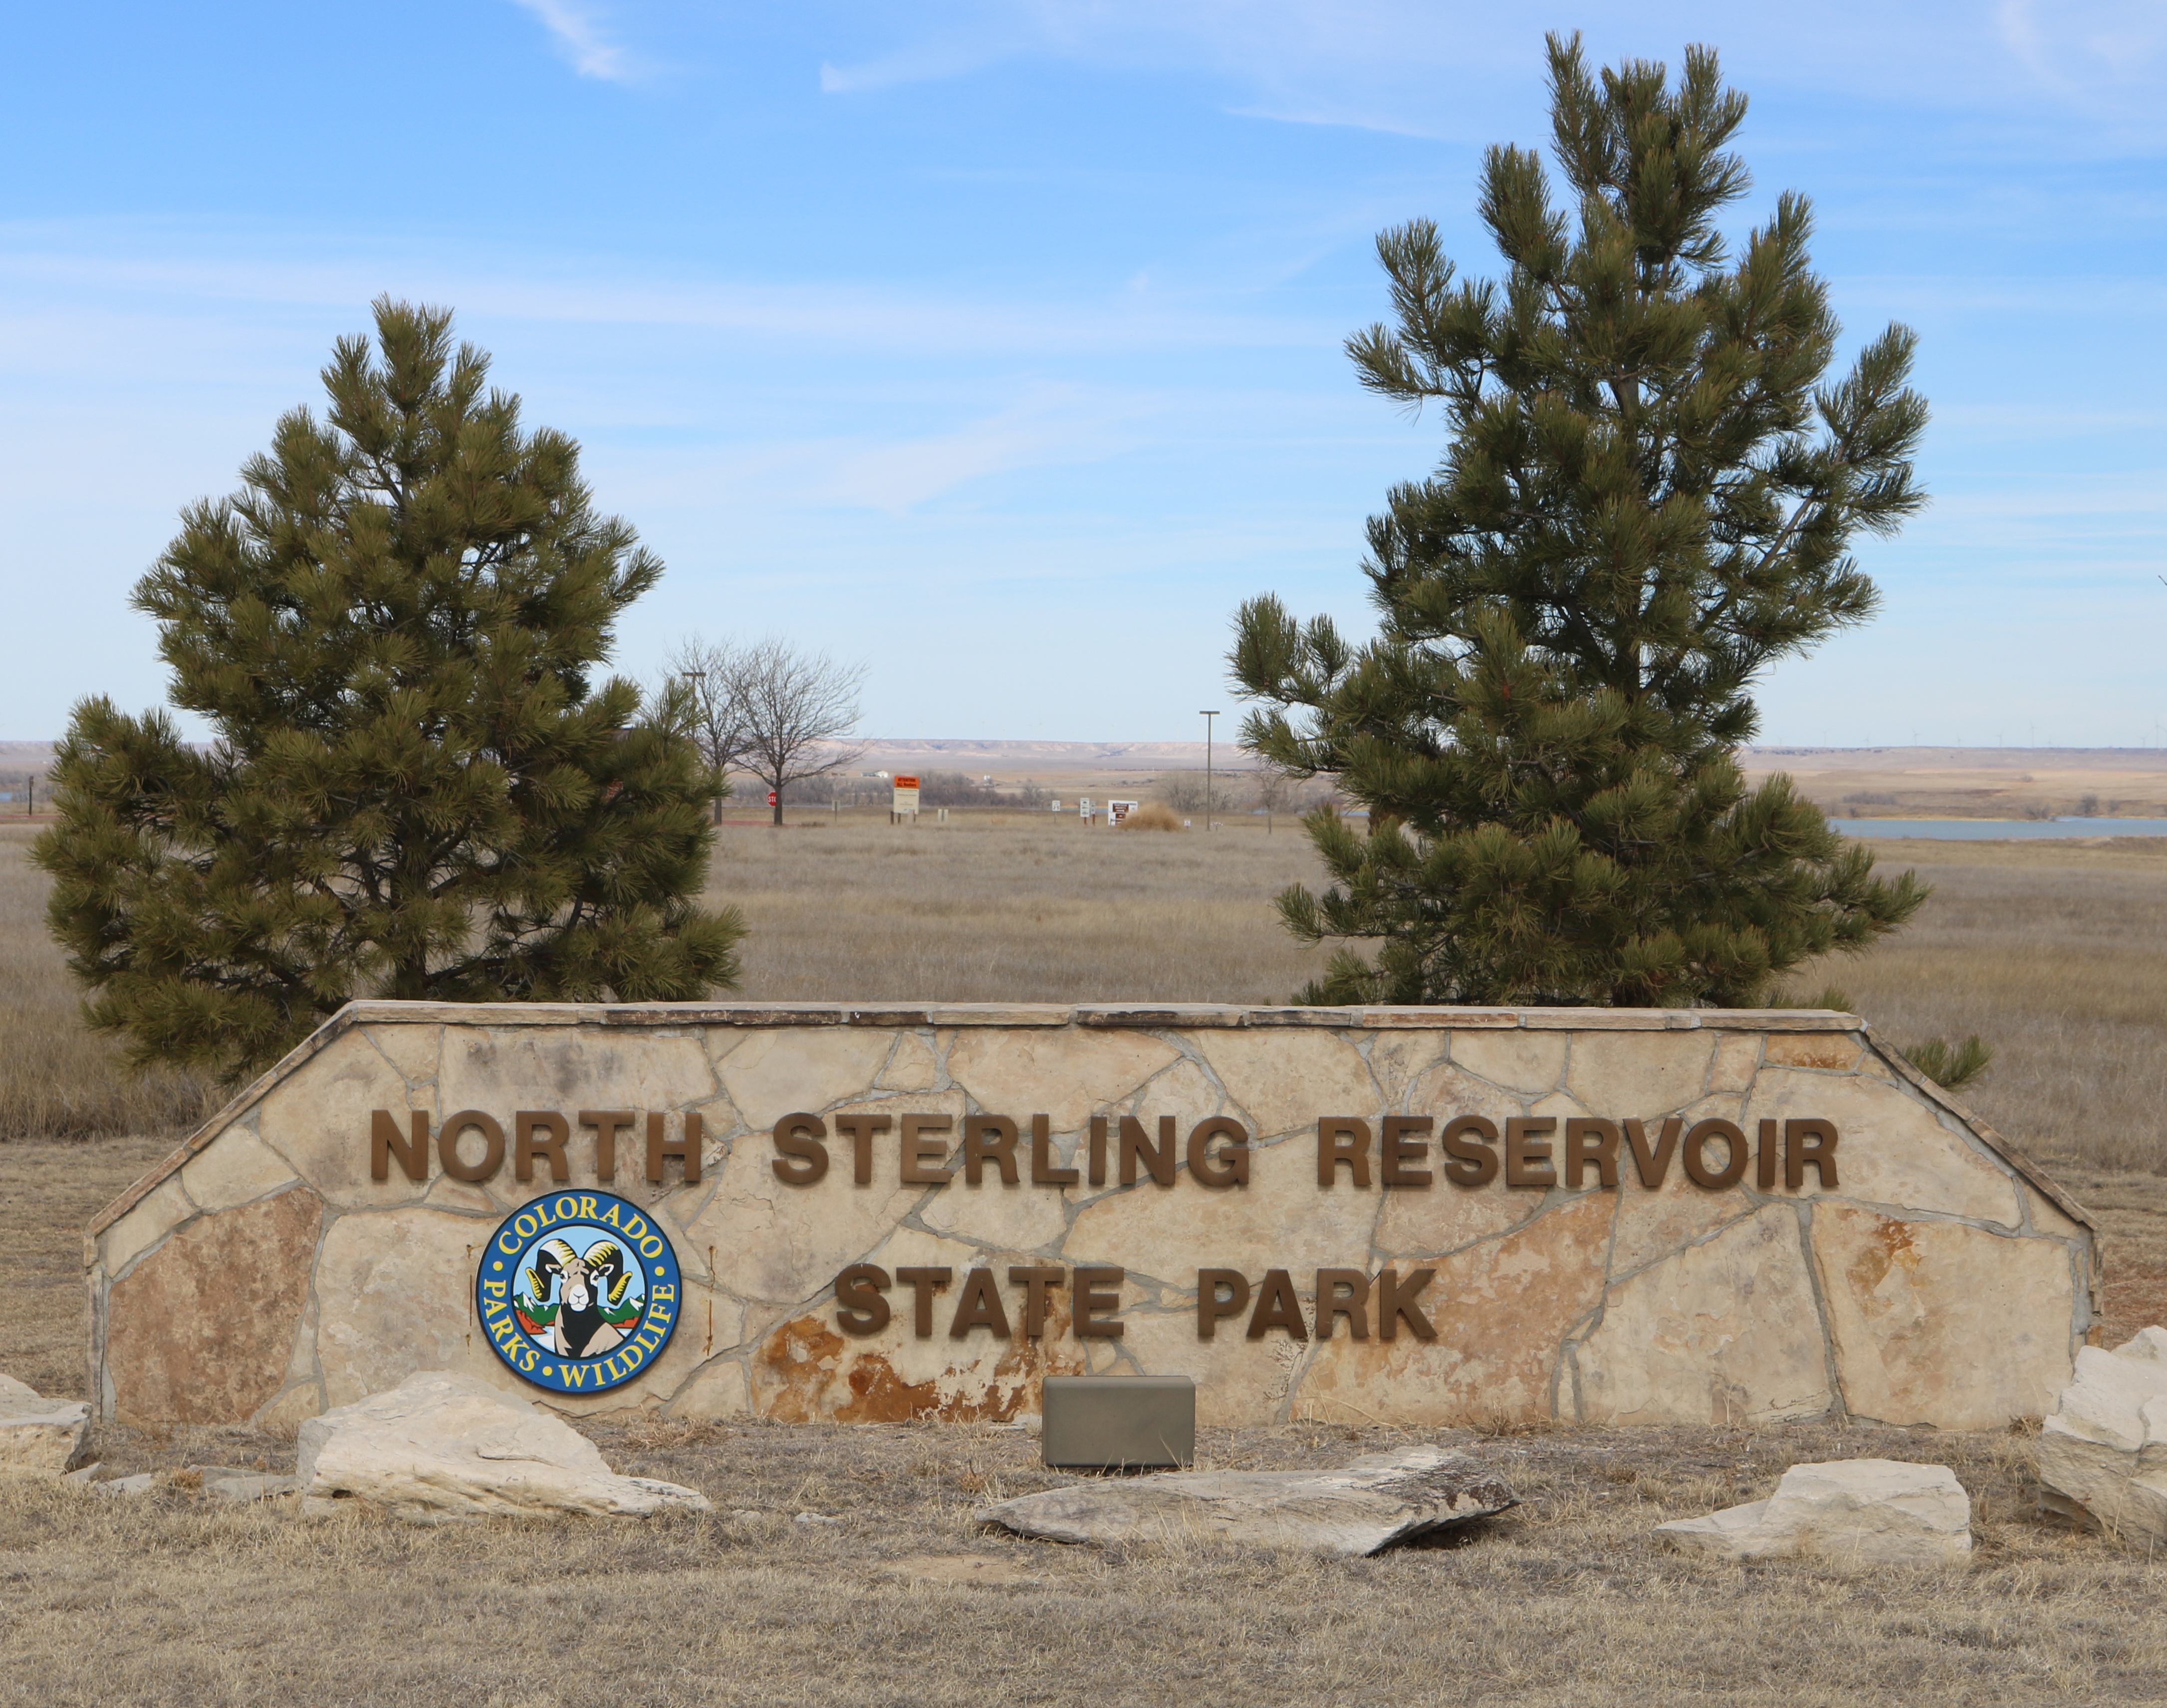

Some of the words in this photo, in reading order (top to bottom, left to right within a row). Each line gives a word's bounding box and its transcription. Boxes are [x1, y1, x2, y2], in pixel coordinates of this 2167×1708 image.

[371, 1109, 702, 1182] NORTH
[771, 1112, 1249, 1187] STERLING
[1318, 1114, 1839, 1188] RESERVOIR
[498, 1196, 663, 1259] COLORADO
[483, 1279, 540, 1372] PARKS
[558, 1283, 675, 1387] WILDLIFE
[835, 1263, 1124, 1337] STATE
[1198, 1268, 1438, 1339] PARK
